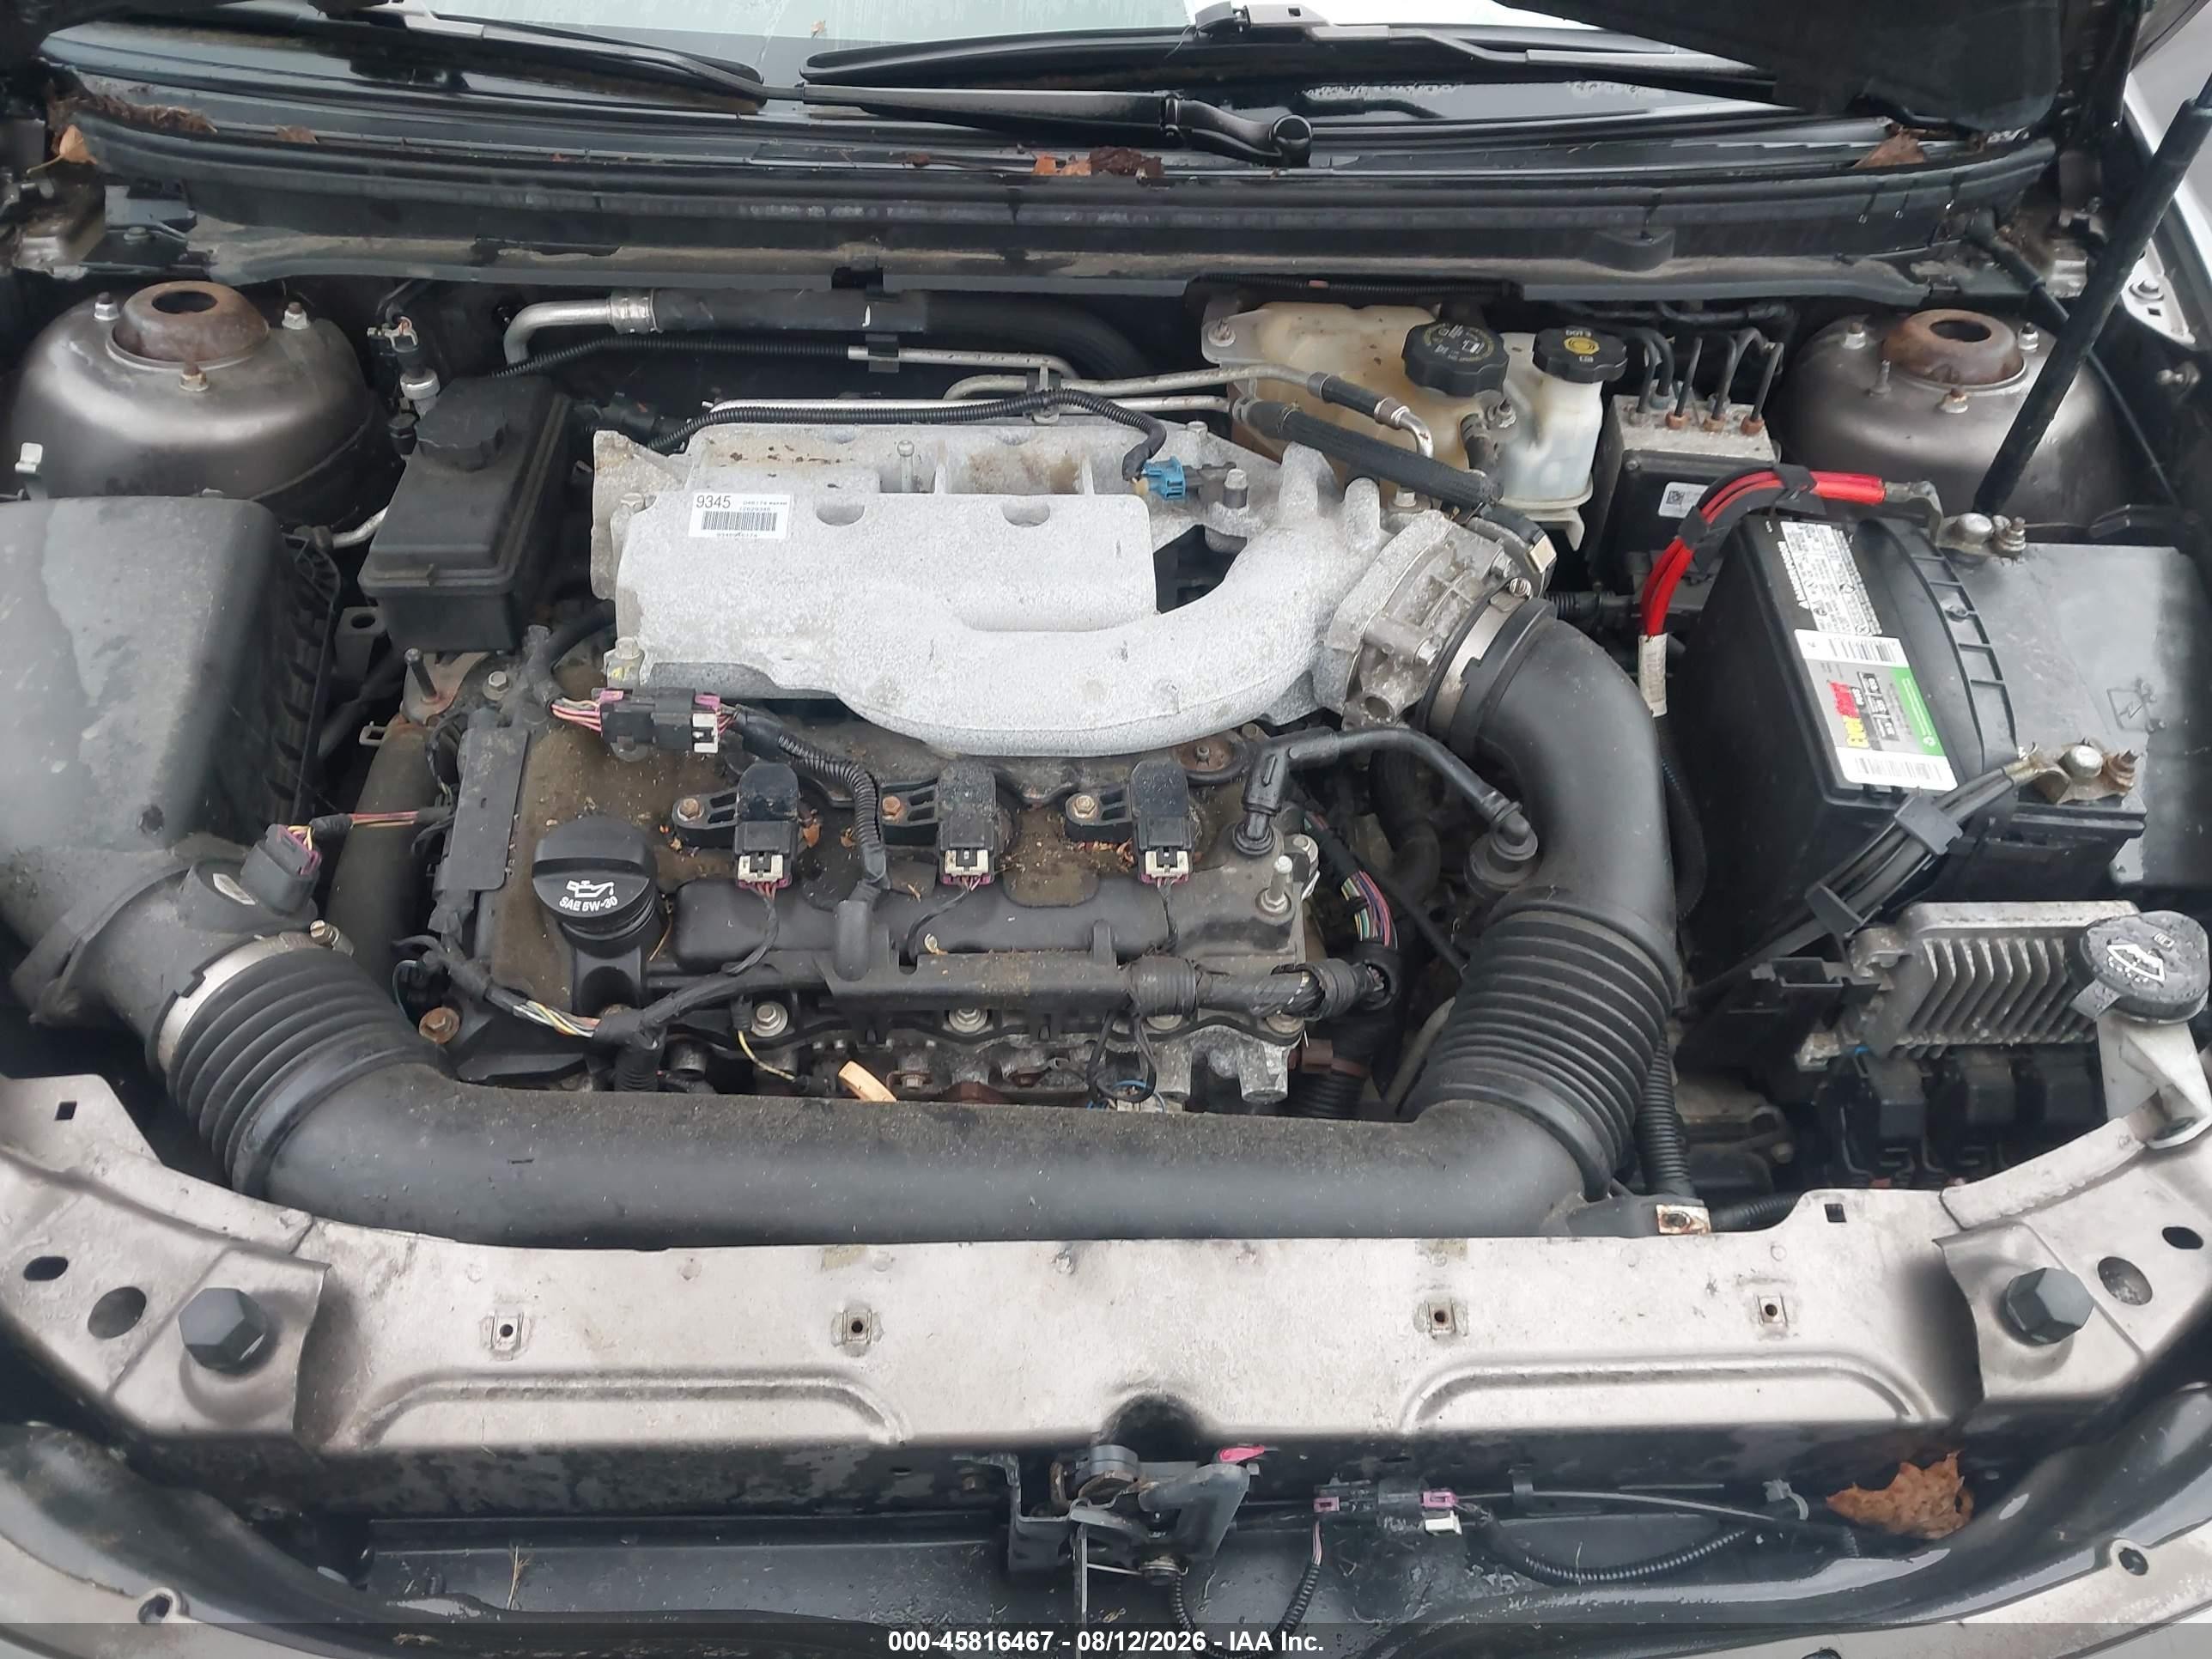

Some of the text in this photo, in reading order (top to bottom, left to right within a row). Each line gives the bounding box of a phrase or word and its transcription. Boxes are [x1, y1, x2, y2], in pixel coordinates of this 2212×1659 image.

[696, 495, 732, 508] 9345
[559, 896, 618, 912] SAE 5W-30
